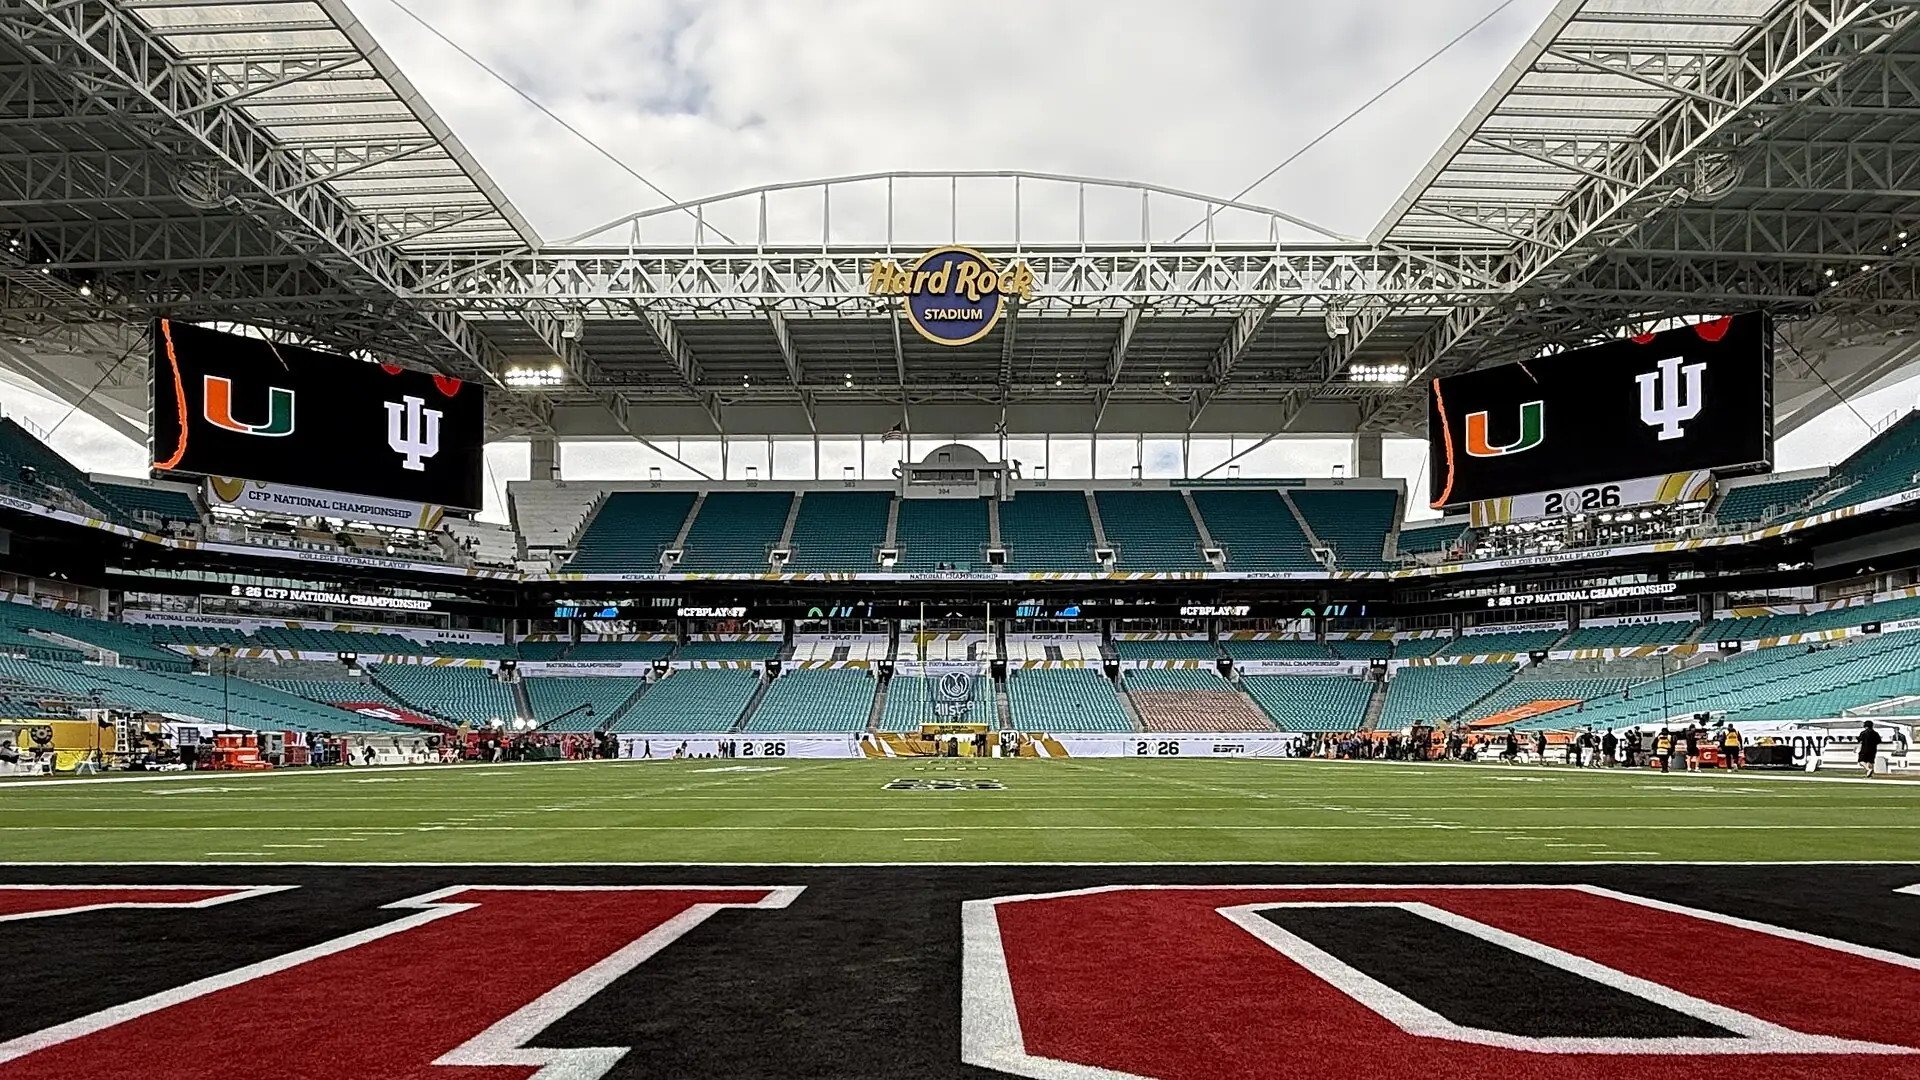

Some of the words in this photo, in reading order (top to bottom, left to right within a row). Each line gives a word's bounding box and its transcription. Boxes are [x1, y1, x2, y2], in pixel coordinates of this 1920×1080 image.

[867, 261, 952, 295] Hard
[954, 260, 1034, 302] Rock
[923, 308, 984, 321] STADIUM
[203, 374, 295, 437] U
[1465, 400, 1544, 458] U
[248, 490, 271, 502] CFP
[273, 493, 331, 510] NATIONAL
[332, 501, 412, 519] CHAMPIONSHIP
[1544, 485, 1621, 516] 2026
[298, 553, 335, 562] COLLEGE
[336, 555, 378, 566] FOOTBALL
[379, 559, 412, 569] PLAYOFF
[1534, 554, 1575, 564] FOOTBALL
[1575, 550, 1612, 560] PLAYOFF
[231, 585, 262, 598] 226
[264, 588, 288, 599] CFP
[289, 590, 349, 604] NATIONAL
[349, 595, 431, 610] CHAMPIONSHIP
[1487, 596, 1512, 607] 226
[1513, 594, 1534, 604] CFP
[1534, 590, 1589, 603] NATIONAL
[1590, 583, 1677, 599] CHAMPIONSHIP
[145, 613, 184, 622] NATIONAL
[1474, 625, 1506, 633] NATIONAL
[743, 742, 786, 756] 2026
[1137, 741, 1180, 755] 2026
[1213, 744, 1244, 753] ESPN
